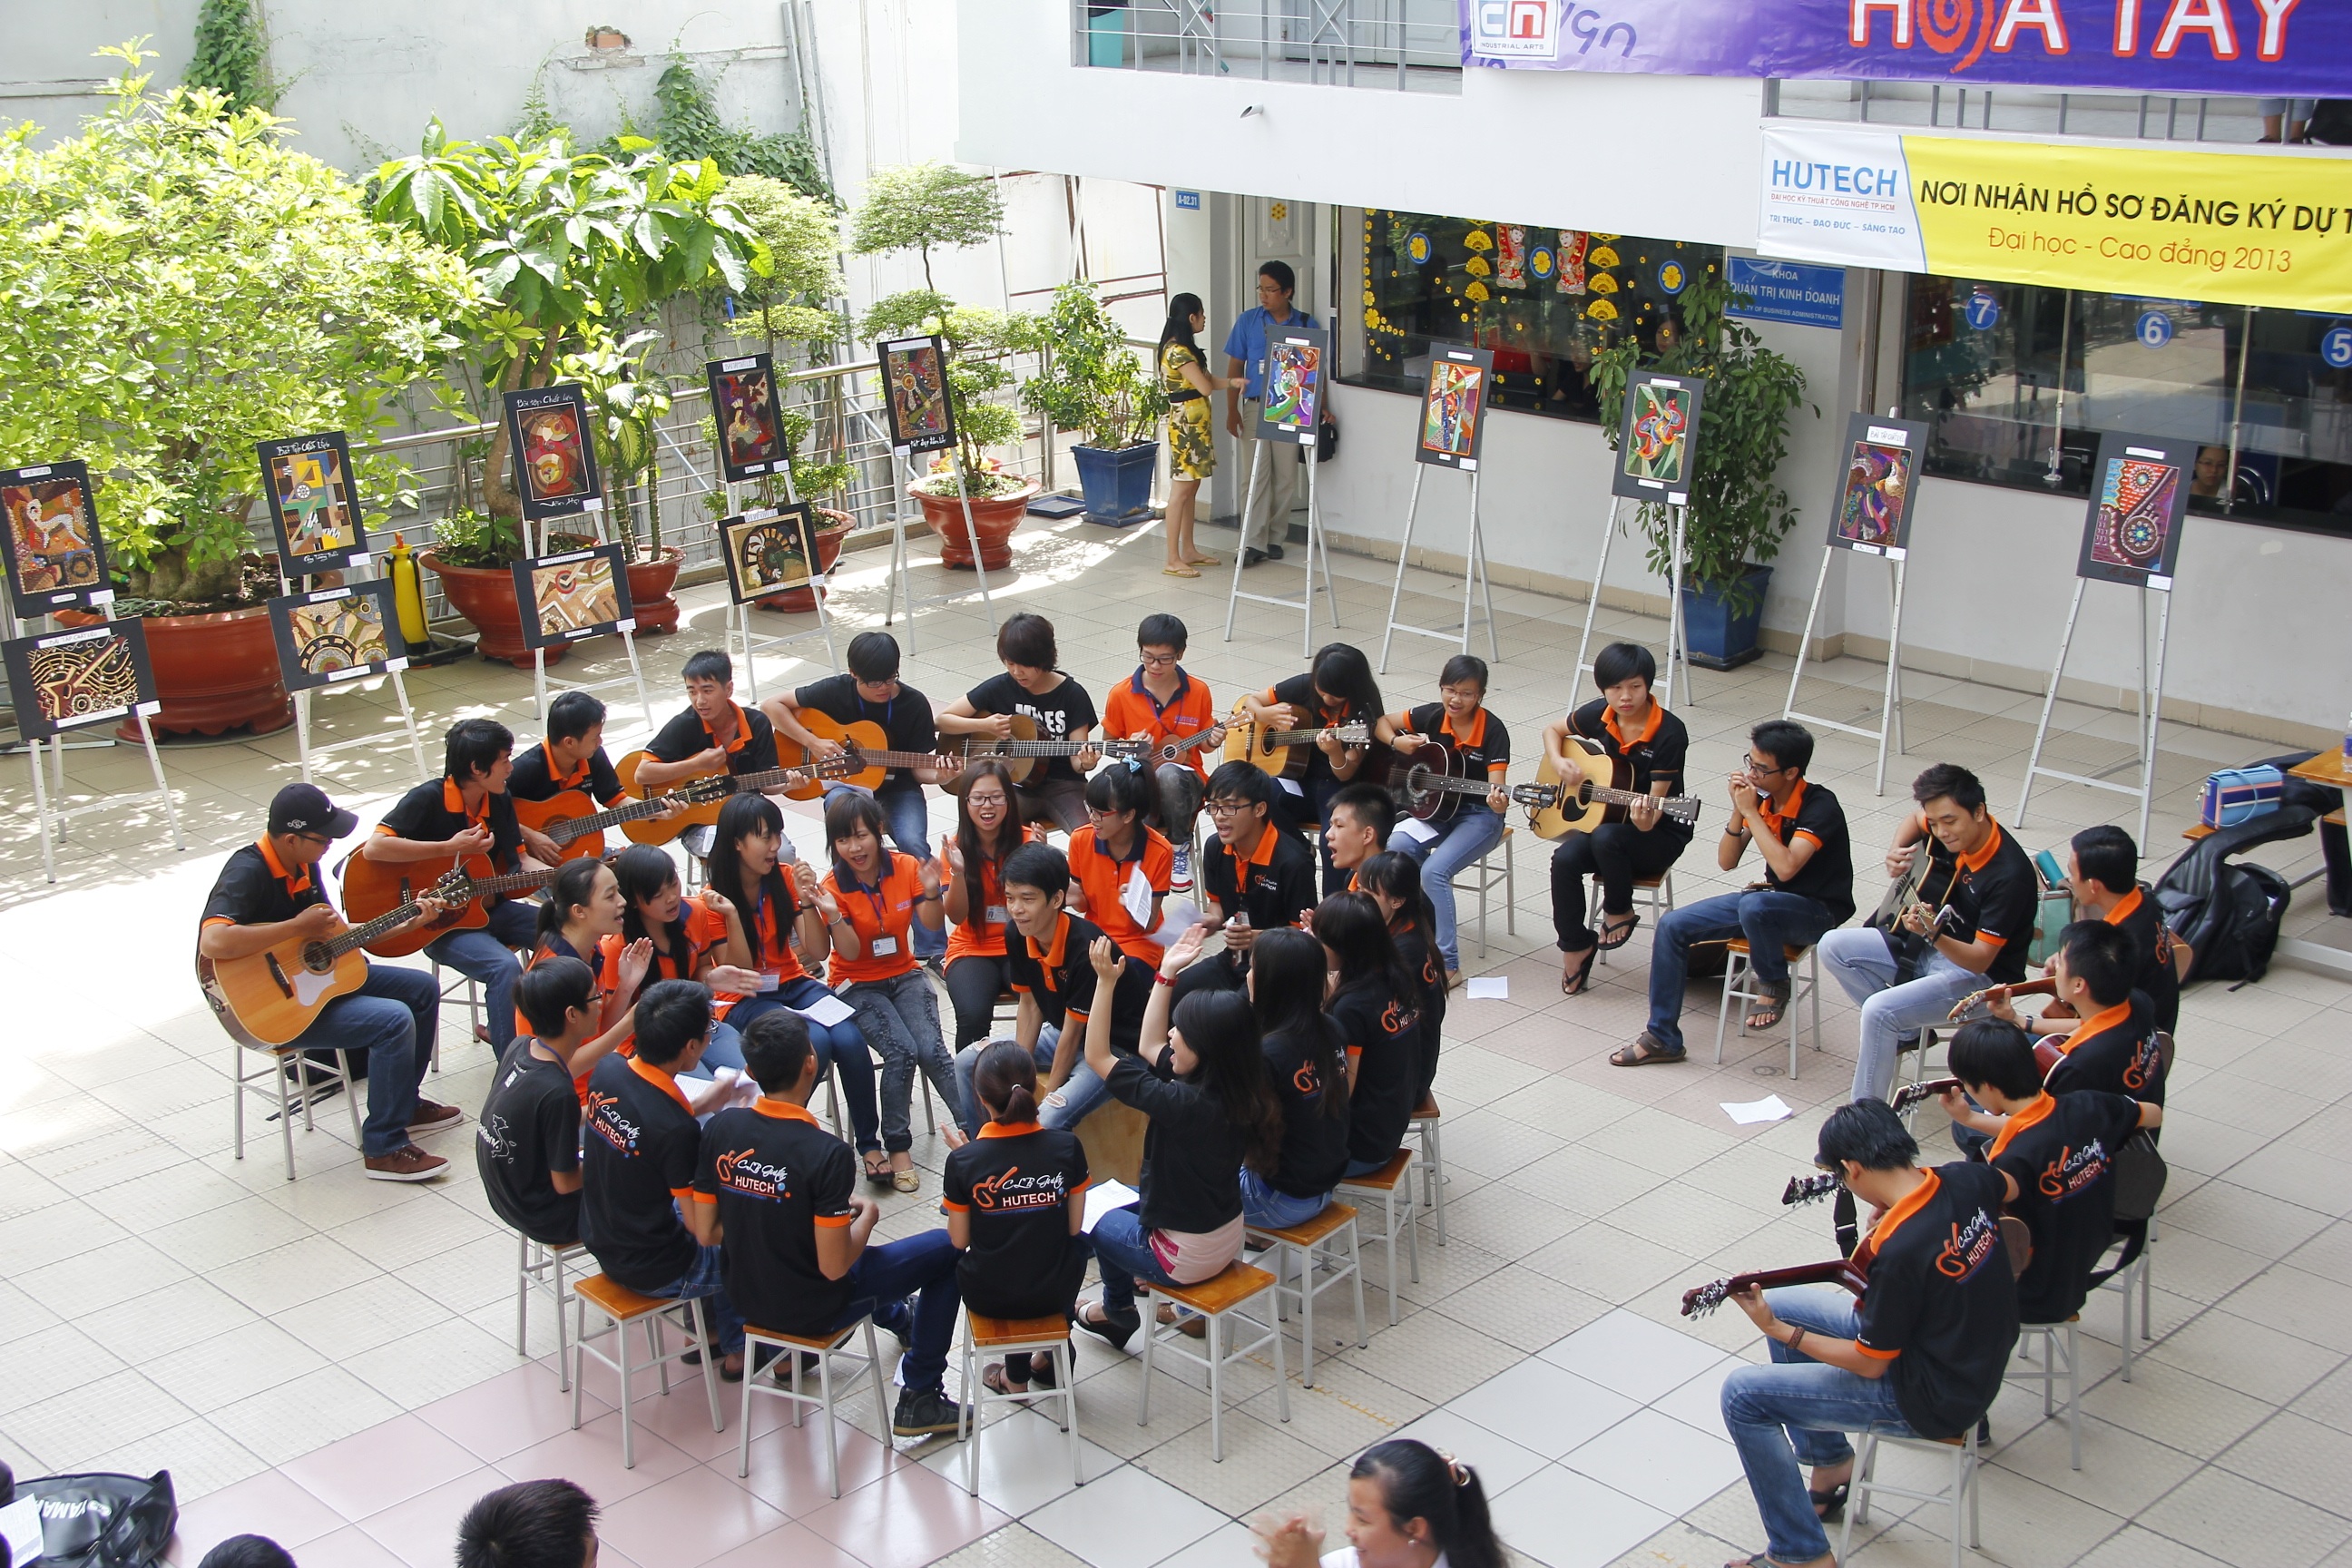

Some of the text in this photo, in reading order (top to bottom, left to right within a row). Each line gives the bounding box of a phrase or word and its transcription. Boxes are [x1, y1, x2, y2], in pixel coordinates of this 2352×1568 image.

[1772, 160, 1897, 197] HUTECH
[1871, 202, 1895, 211] TP.HCM
[1920, 180, 1966, 206] NƠI
[1974, 182, 2049, 215] NHẬN
[2056, 182, 2097, 217] HỒ
[2104, 193, 2144, 220] SƠ
[2150, 193, 2239, 227] ĐĂNG
[2247, 198, 2287, 230] KÝ
[2292, 205, 2338, 239] DỰ
[1988, 227, 2292, 272] Đại học Cao đẳng 2013
[1772, 270, 1798, 281] KHOA
[1760, 286, 1776, 299] TRỊ
[1779, 288, 1802, 301] KINH
[1805, 290, 1840, 305] DOANH
[1763, 308, 1790, 316] BUSINESS
[1792, 310, 1838, 321] ADMINISTRATION
[1974, 299, 1991, 325] 7
[2144, 316, 2162, 344] 6
[2333, 333, 2352, 362] 5
[595, 1117, 627, 1148] HUTECH
[735, 1175, 776, 1194] HUTECH
[2068, 1159, 2102, 1189] HUTECH
[1003, 1191, 1056, 1207] HUTECH
[1965, 1229, 1994, 1266] HUTECH
